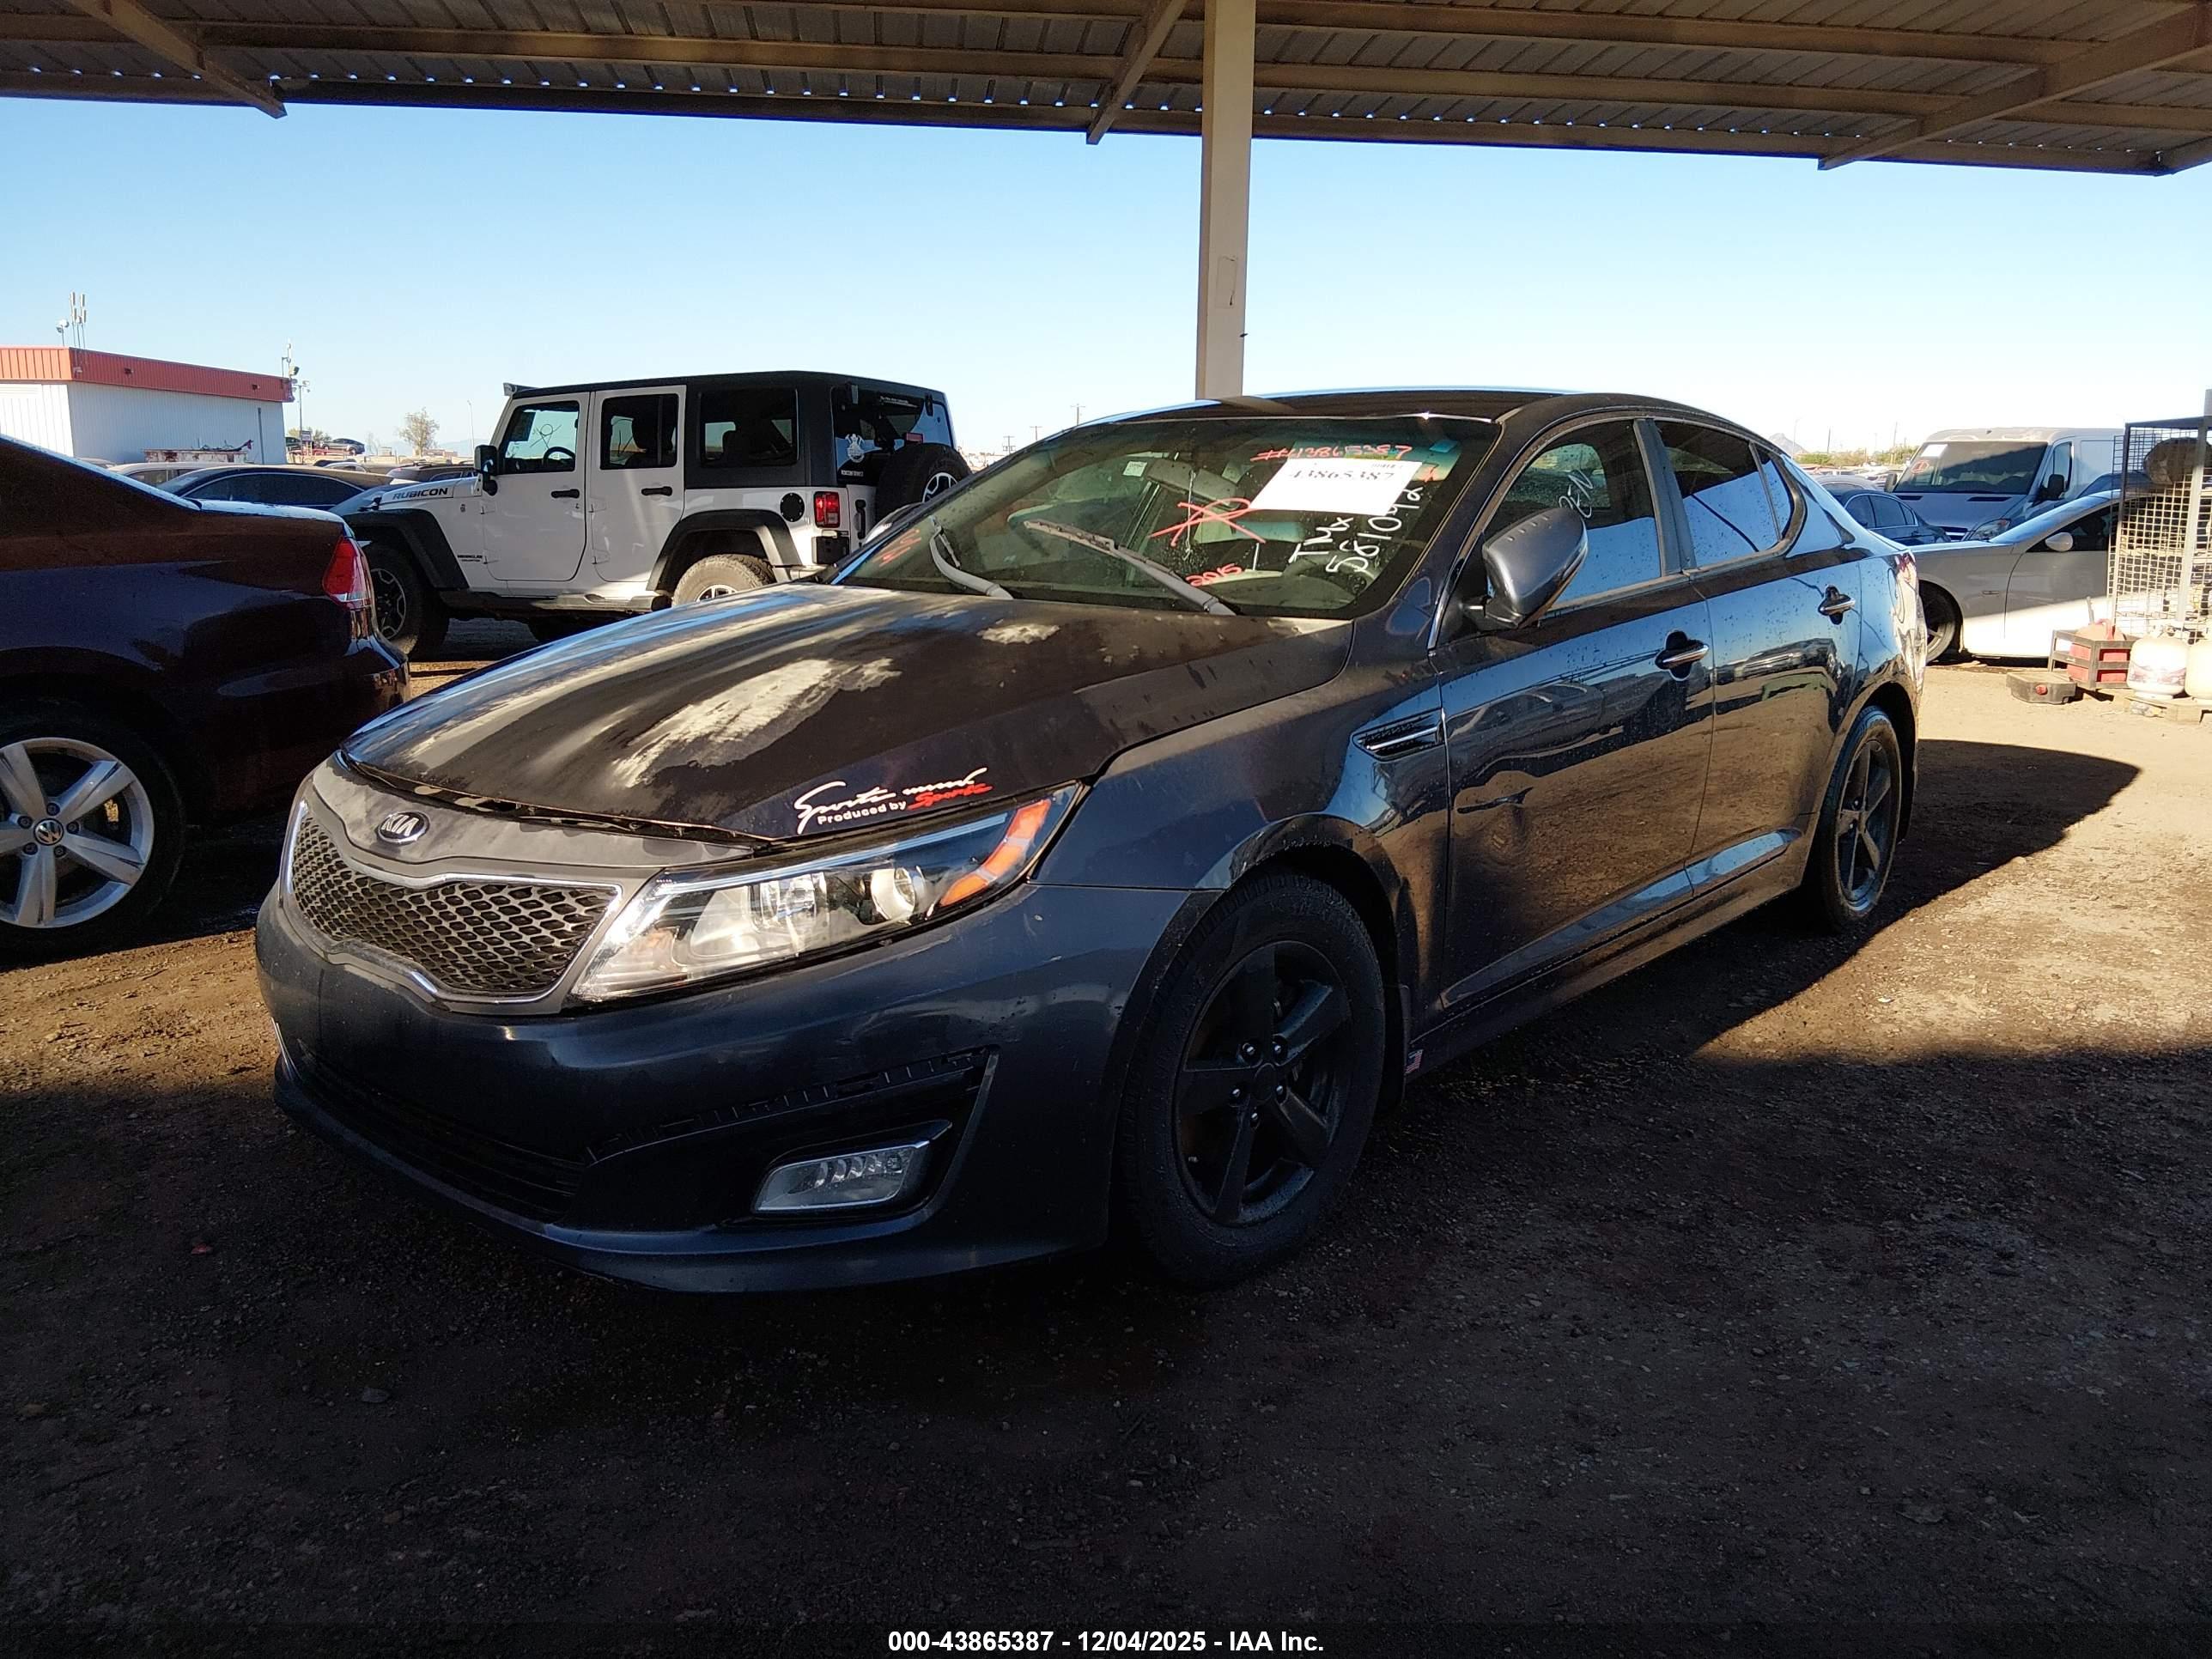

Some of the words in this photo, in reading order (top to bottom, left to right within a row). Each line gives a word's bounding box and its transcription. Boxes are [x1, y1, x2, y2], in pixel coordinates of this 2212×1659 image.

[392, 487, 449, 501] RUBICON
[817, 803, 888, 825] Produced
[889, 799, 908, 811] by
